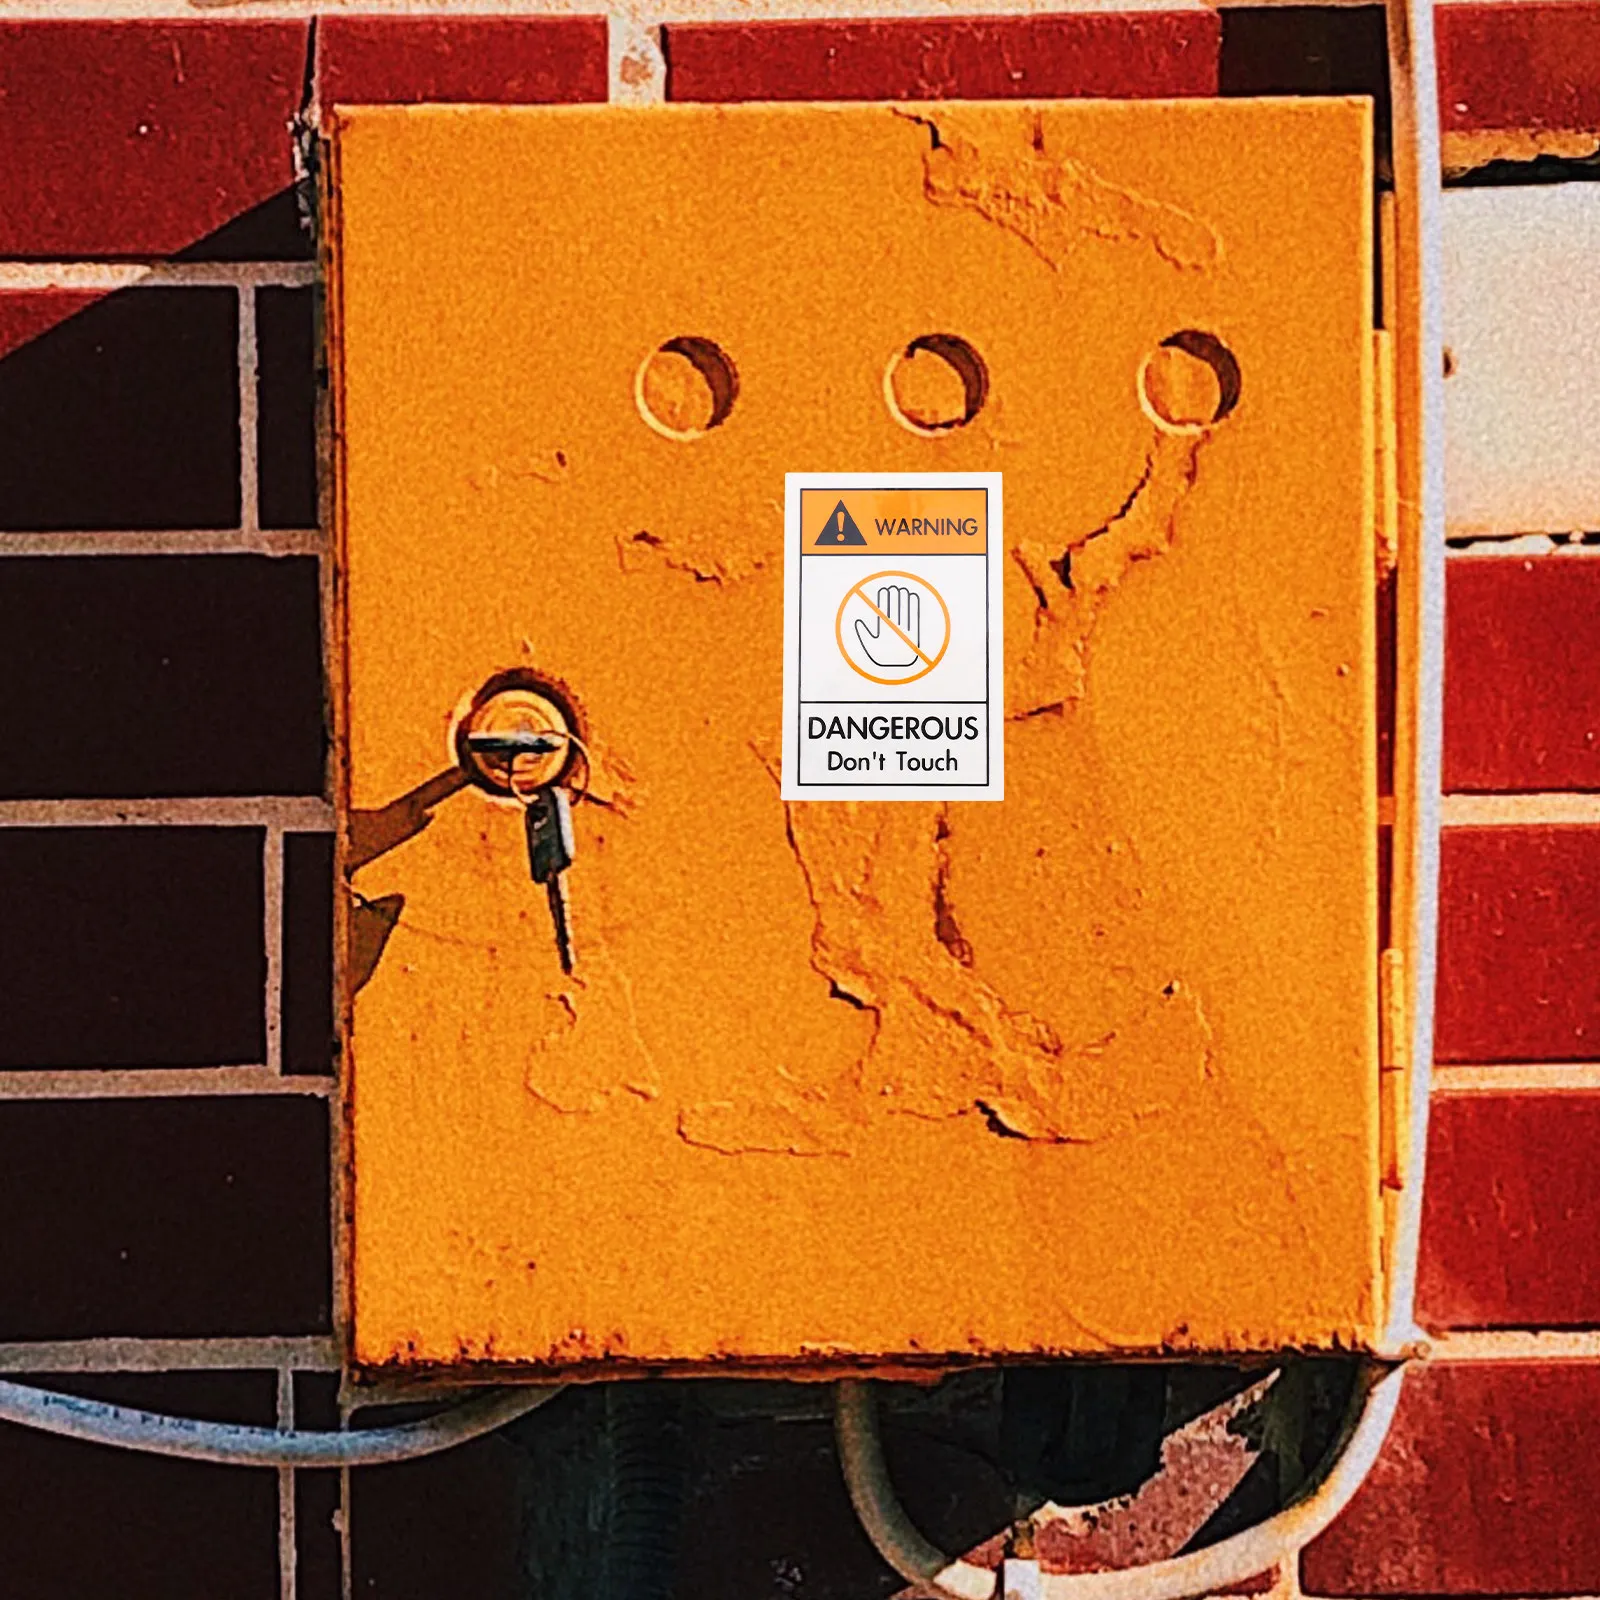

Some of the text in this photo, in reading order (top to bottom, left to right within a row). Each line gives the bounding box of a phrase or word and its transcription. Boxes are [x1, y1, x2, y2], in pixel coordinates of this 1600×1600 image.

[874, 517, 978, 536] WARNING
[808, 715, 979, 741] DANGEROUS
[827, 749, 958, 772] Don't Touch
